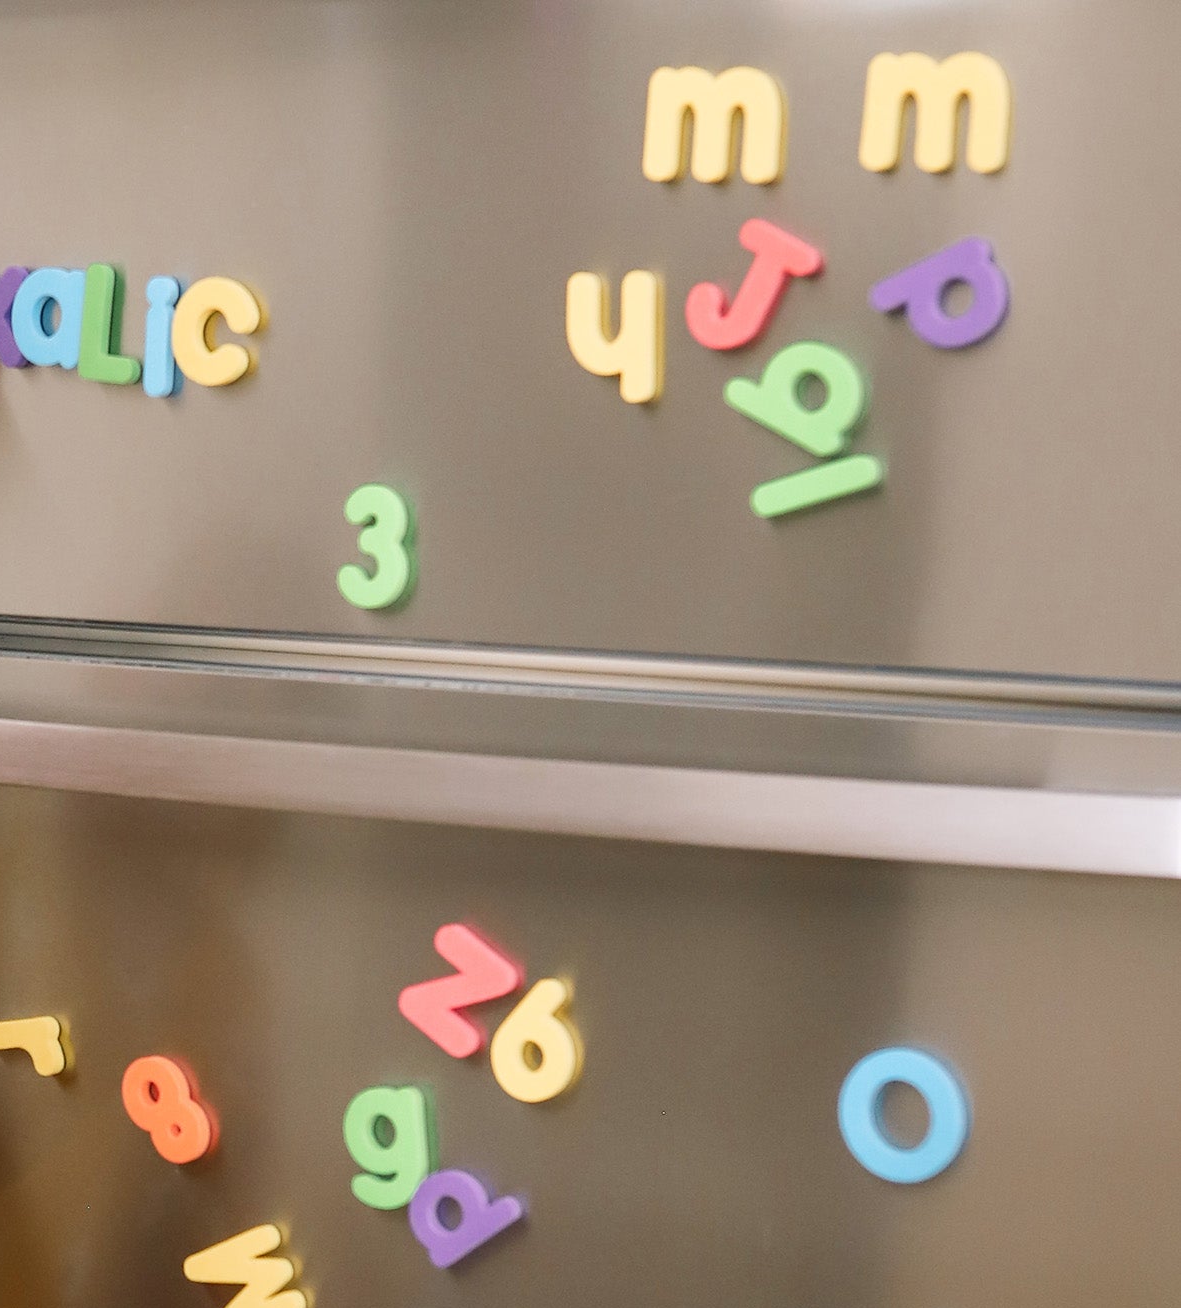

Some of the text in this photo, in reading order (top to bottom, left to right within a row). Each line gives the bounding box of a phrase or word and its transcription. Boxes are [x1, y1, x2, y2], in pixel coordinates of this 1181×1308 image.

[642, 51, 1011, 184] m m
[337, 484, 417, 609] 3
[490, 977, 583, 1103] 6
[122, 1055, 215, 1165] 8
[343, 1084, 435, 1210] g
